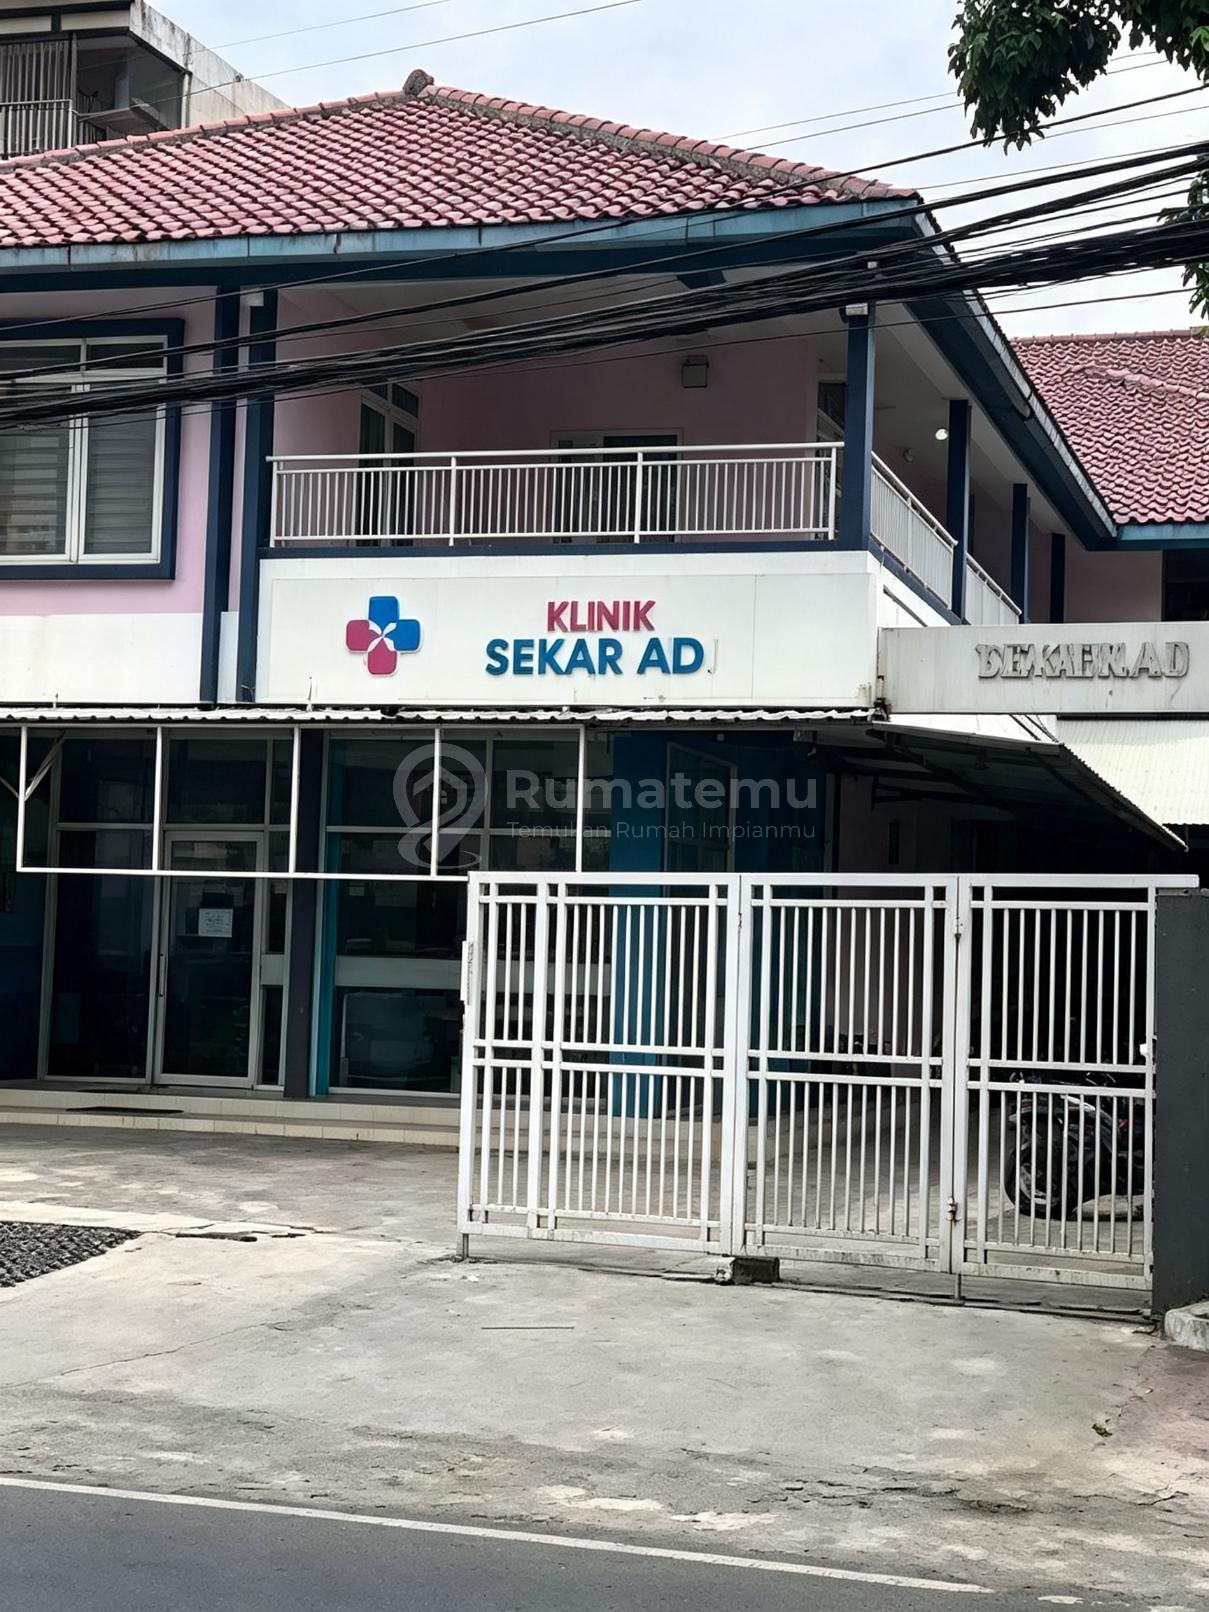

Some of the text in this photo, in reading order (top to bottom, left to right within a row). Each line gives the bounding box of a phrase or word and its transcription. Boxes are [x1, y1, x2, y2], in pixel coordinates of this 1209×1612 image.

[547, 600, 656, 632] KLINIK
[485, 637, 705, 676] SEKAR AD
